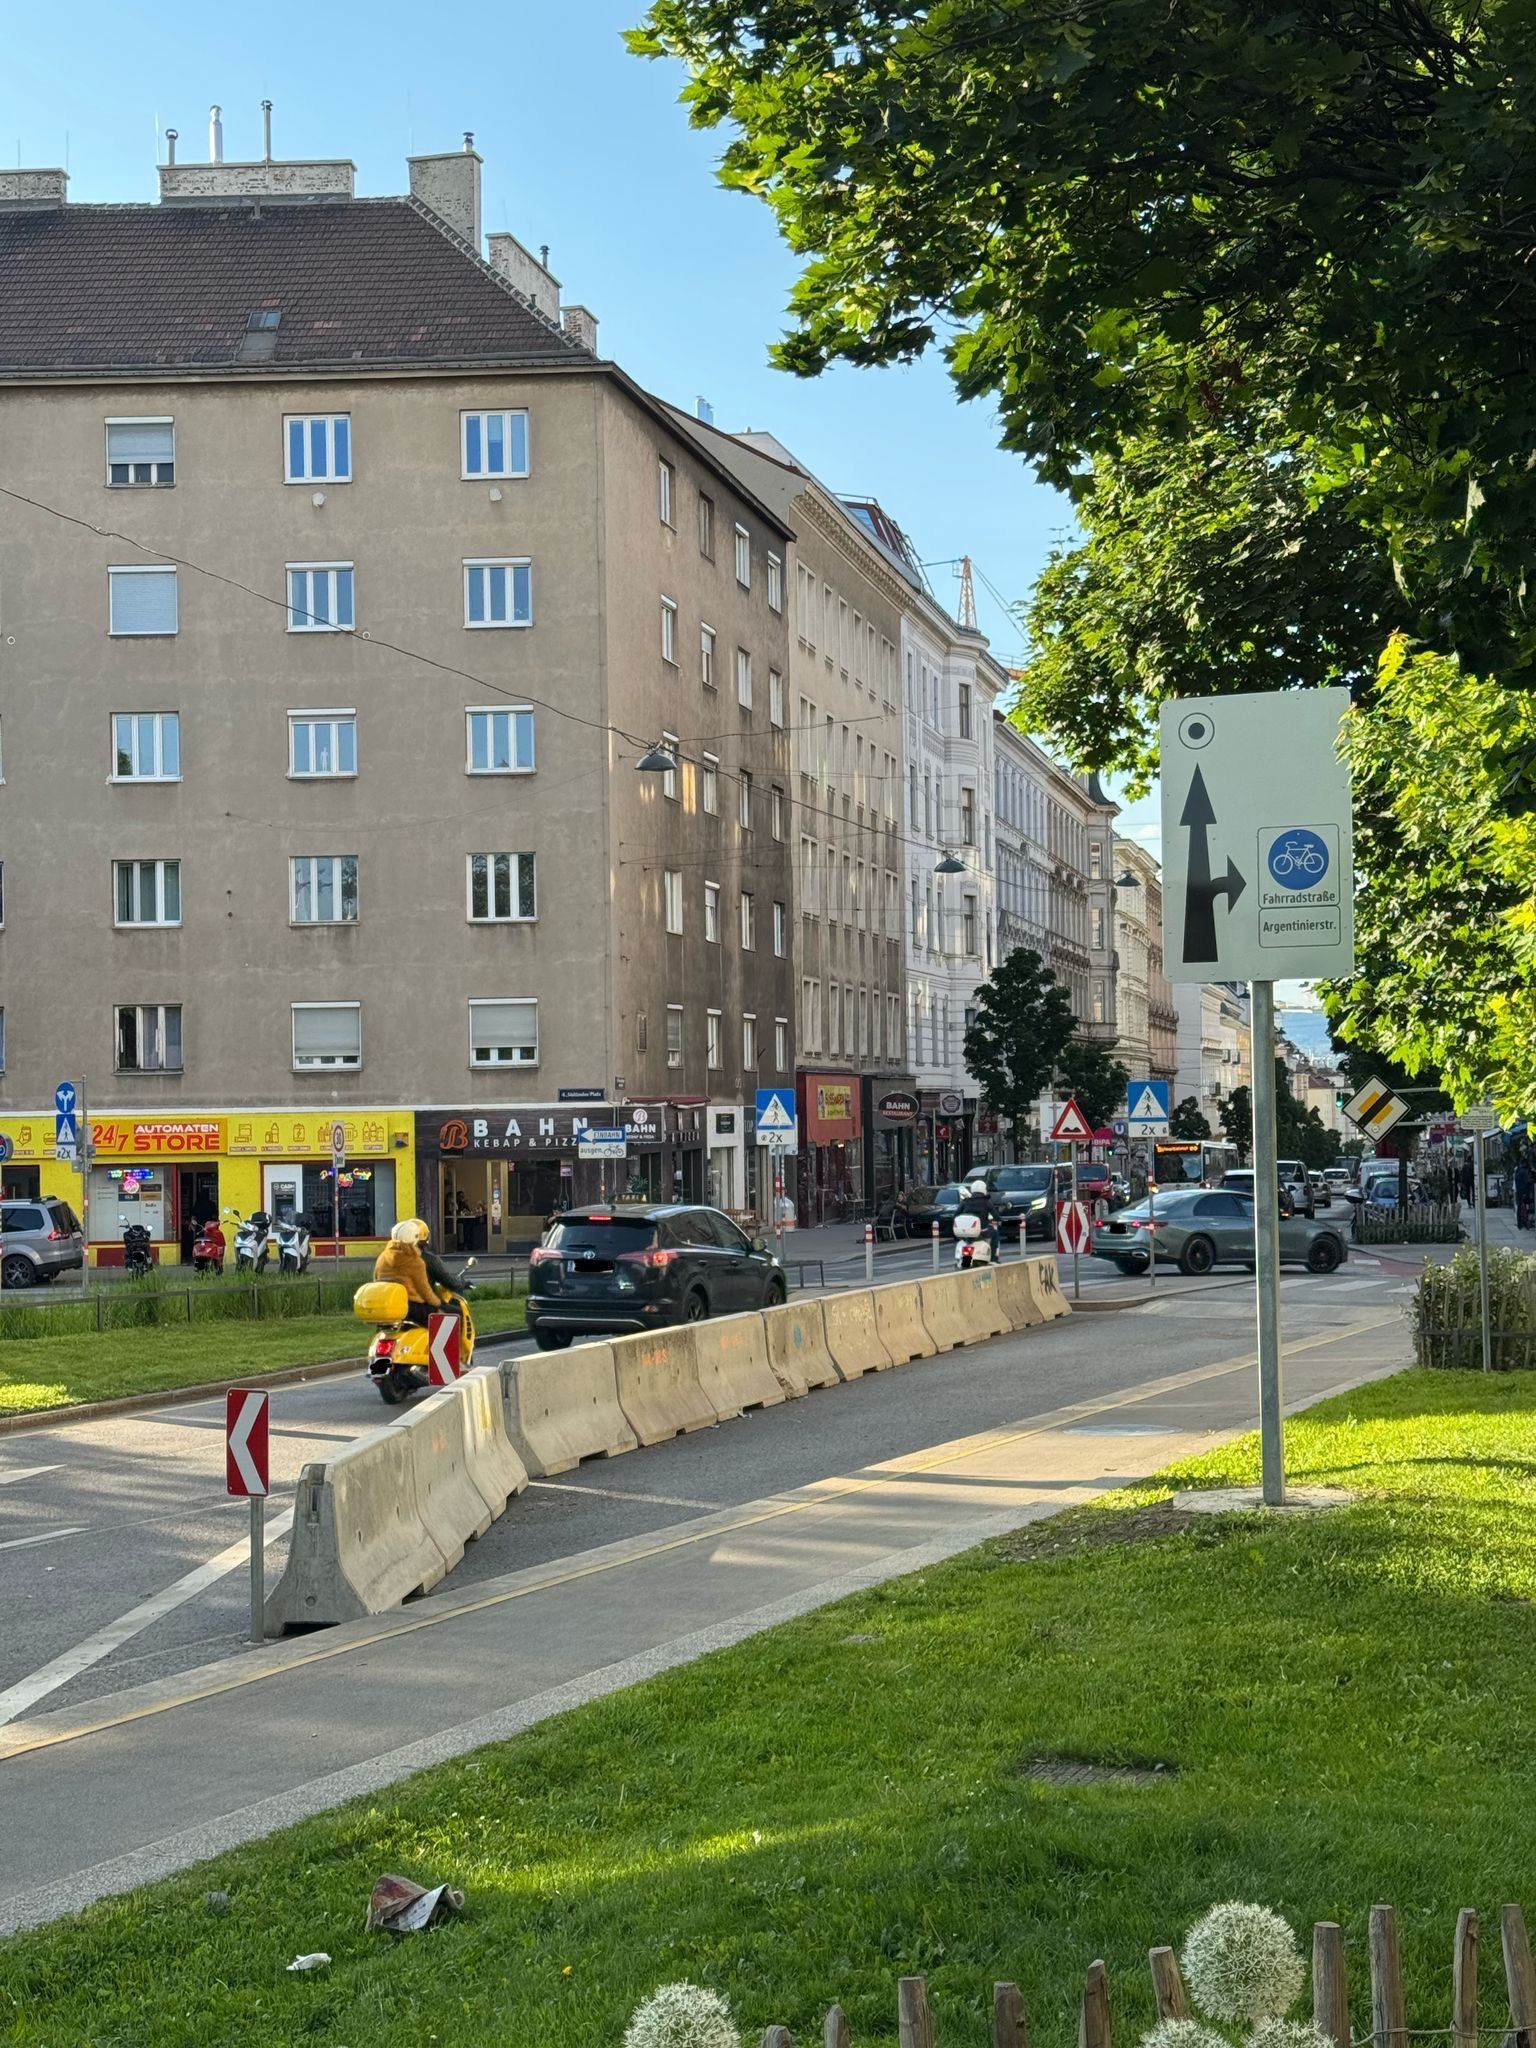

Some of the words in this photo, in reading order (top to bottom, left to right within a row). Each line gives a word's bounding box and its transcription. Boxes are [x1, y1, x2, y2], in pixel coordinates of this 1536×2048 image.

[1263, 891, 1336, 904] Fahrradstraße
[1263, 920, 1337, 934] Argentinierstr.
[886, 1101, 911, 1110] BAHN
[135, 1123, 219, 1133] AUTOMATEN
[473, 1117, 588, 1137] BAHN
[625, 1124, 656, 1133] BAHN
[1114, 1124, 1125, 1135] U
[1141, 1123, 1156, 1136] 2x
[92, 1124, 129, 1152] 24/7
[134, 1134, 220, 1151] STORE
[474, 1138, 521, 1148] KEBAP
[529, 1137, 537, 1147] &
[545, 1137, 578, 1147] PIZZ
[768, 1131, 783, 1143] 2x
[61, 1147, 71, 1159] 2x
